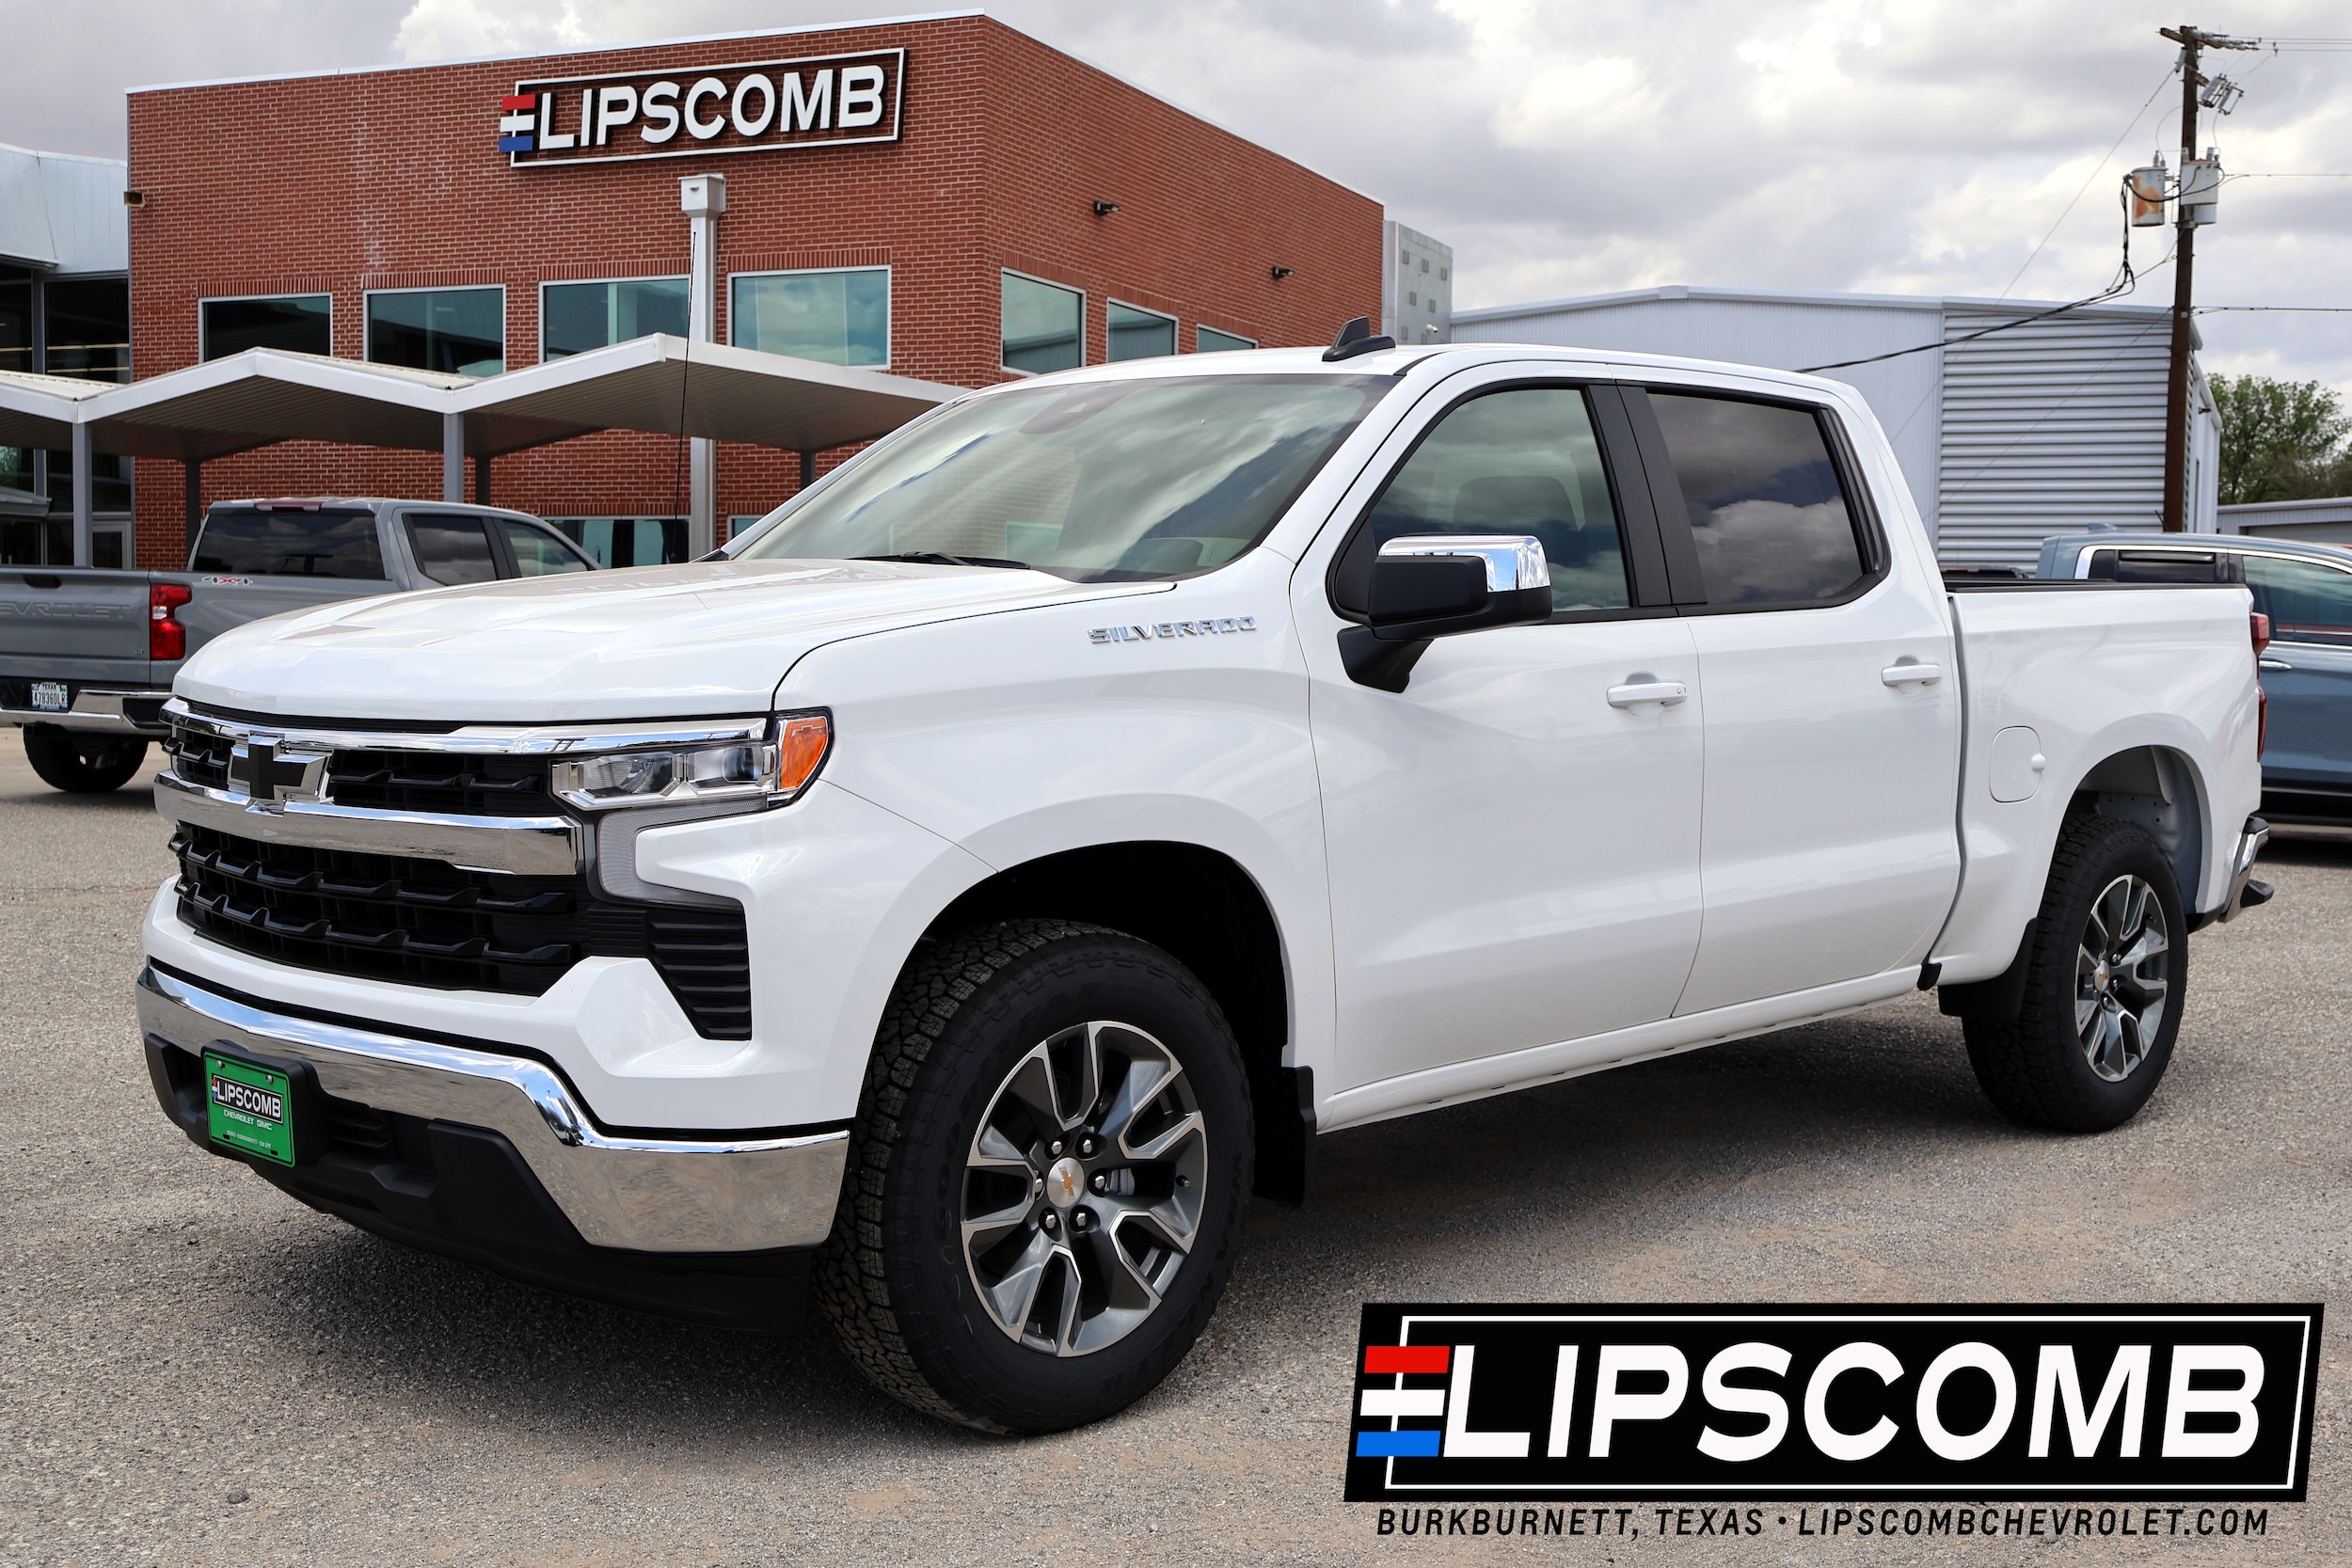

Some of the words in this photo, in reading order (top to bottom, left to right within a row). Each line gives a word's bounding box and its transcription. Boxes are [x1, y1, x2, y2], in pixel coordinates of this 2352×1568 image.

[539, 65, 885, 150] LIPSCOMB
[1087, 616, 1257, 644] SILVERADO
[216, 1080, 281, 1118] LIPSCOMB
[223, 1109, 255, 1125] CHEVROLET
[257, 1119, 273, 1131] GMC
